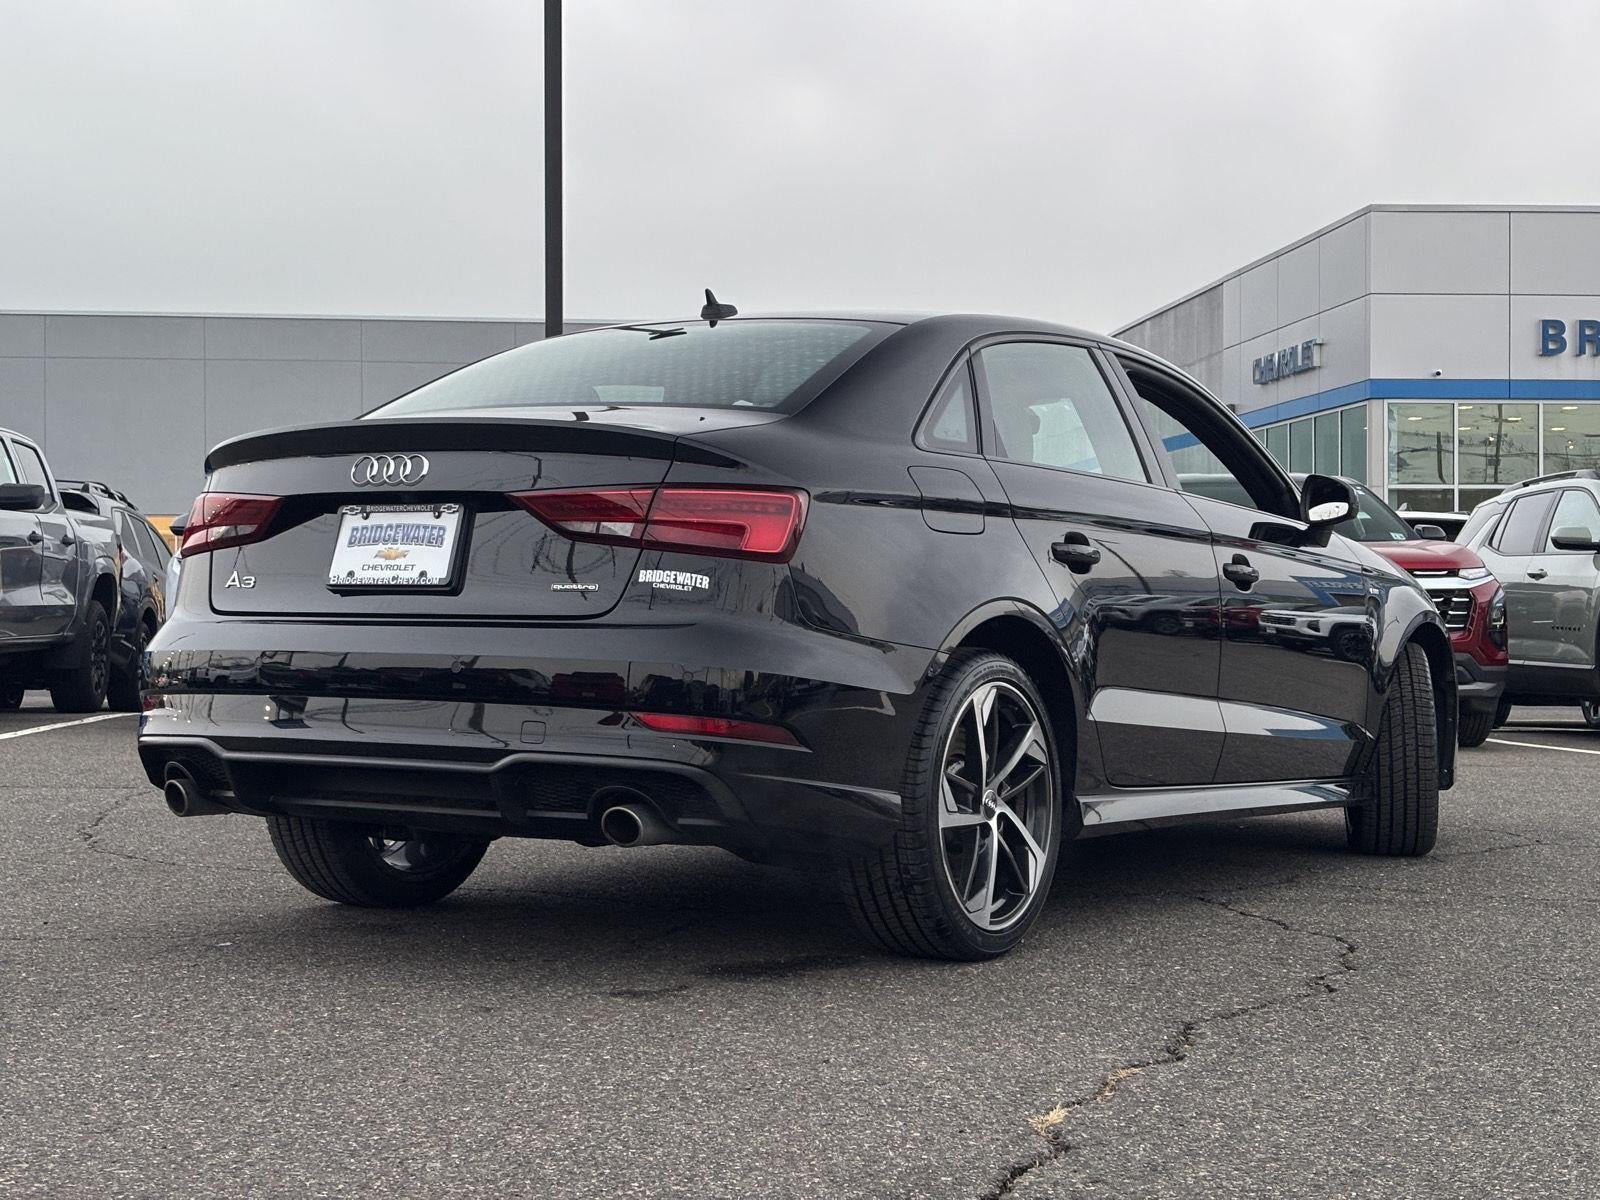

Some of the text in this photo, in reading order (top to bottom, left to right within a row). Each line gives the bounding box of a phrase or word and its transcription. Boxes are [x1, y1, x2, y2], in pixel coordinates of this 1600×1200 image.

[1252, 337, 1323, 384] CHEVROLET
[347, 523, 446, 548] BRIDGEWATER
[361, 563, 416, 571] CHEVROLET
[224, 570, 256, 589] A3
[638, 569, 710, 590] BRIDGEWATER
[652, 582, 693, 592] CHEVROLET
